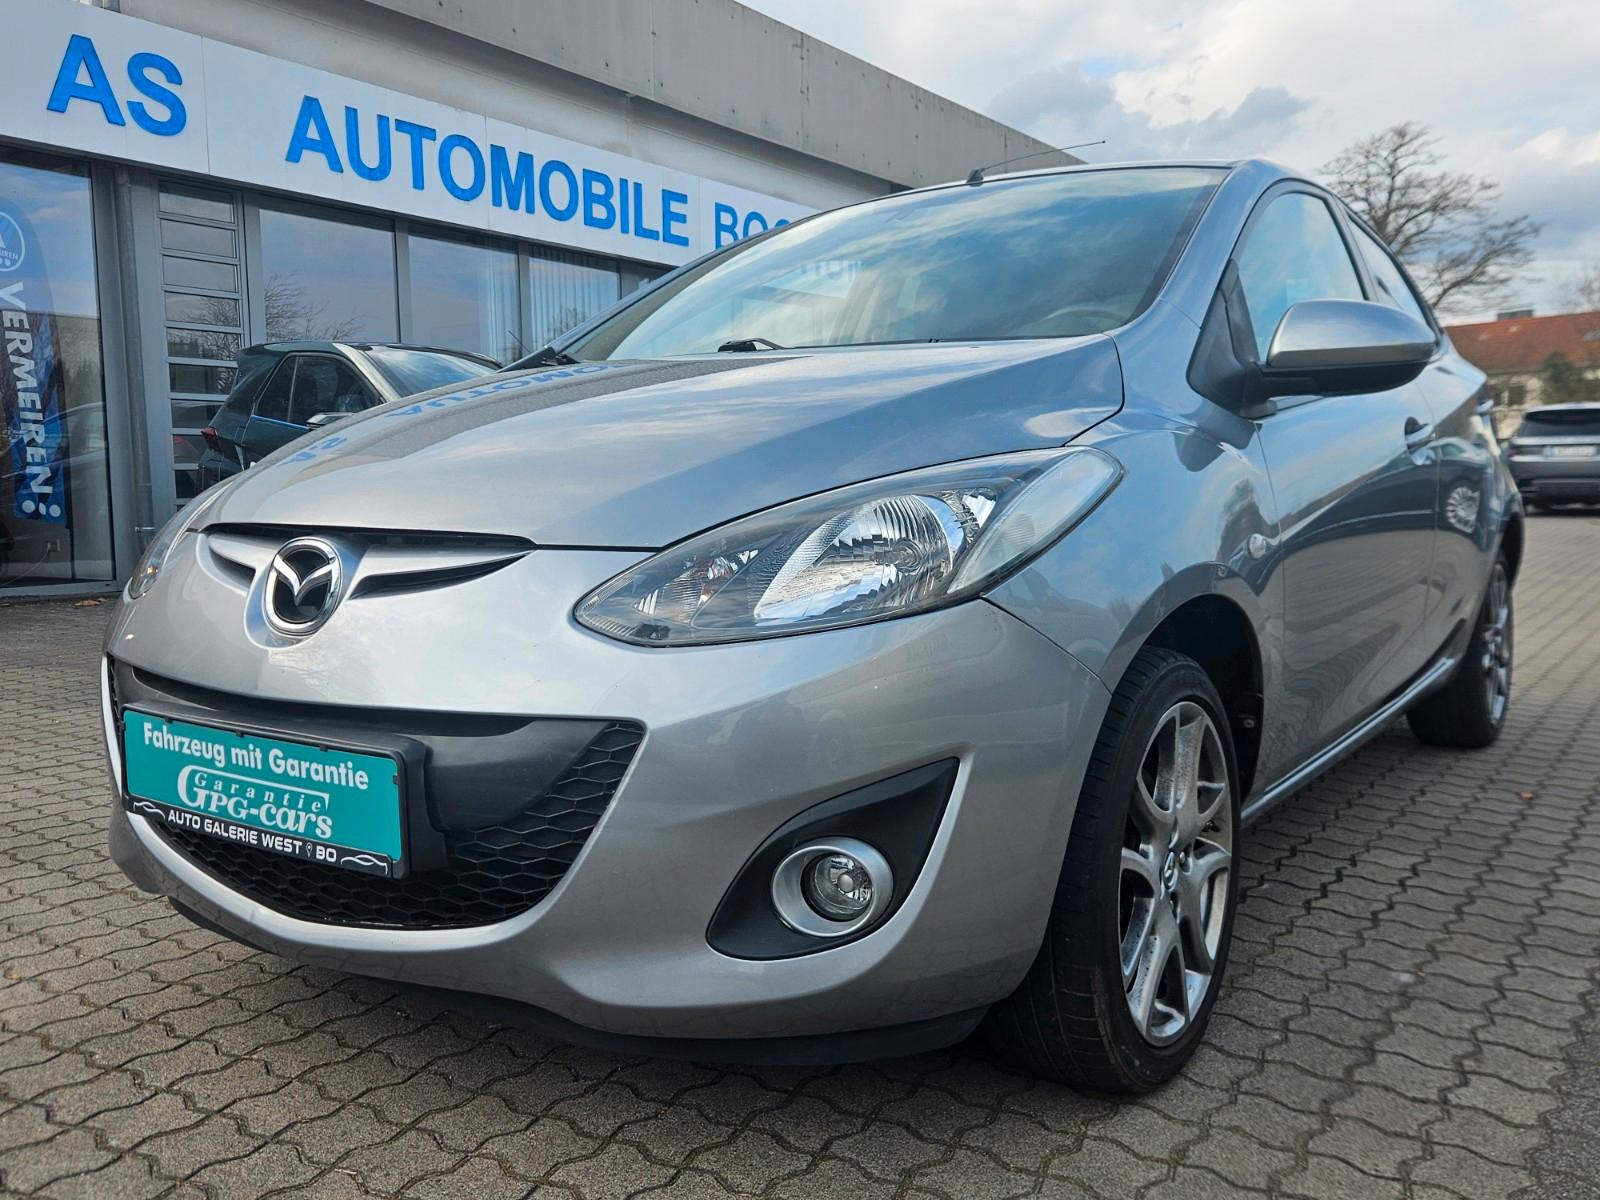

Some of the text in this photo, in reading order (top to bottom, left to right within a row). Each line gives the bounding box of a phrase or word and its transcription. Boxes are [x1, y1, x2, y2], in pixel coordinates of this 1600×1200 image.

[47, 34, 188, 137] AS
[285, 95, 690, 248] AUTOMOBILE
[0, 281, 54, 494] VERMEIREN
[143, 722, 370, 790] Fahrzeug mit Garantie
[194, 771, 321, 813] Garantie
[167, 809, 338, 863] AUTO GALERIE WEST BO
